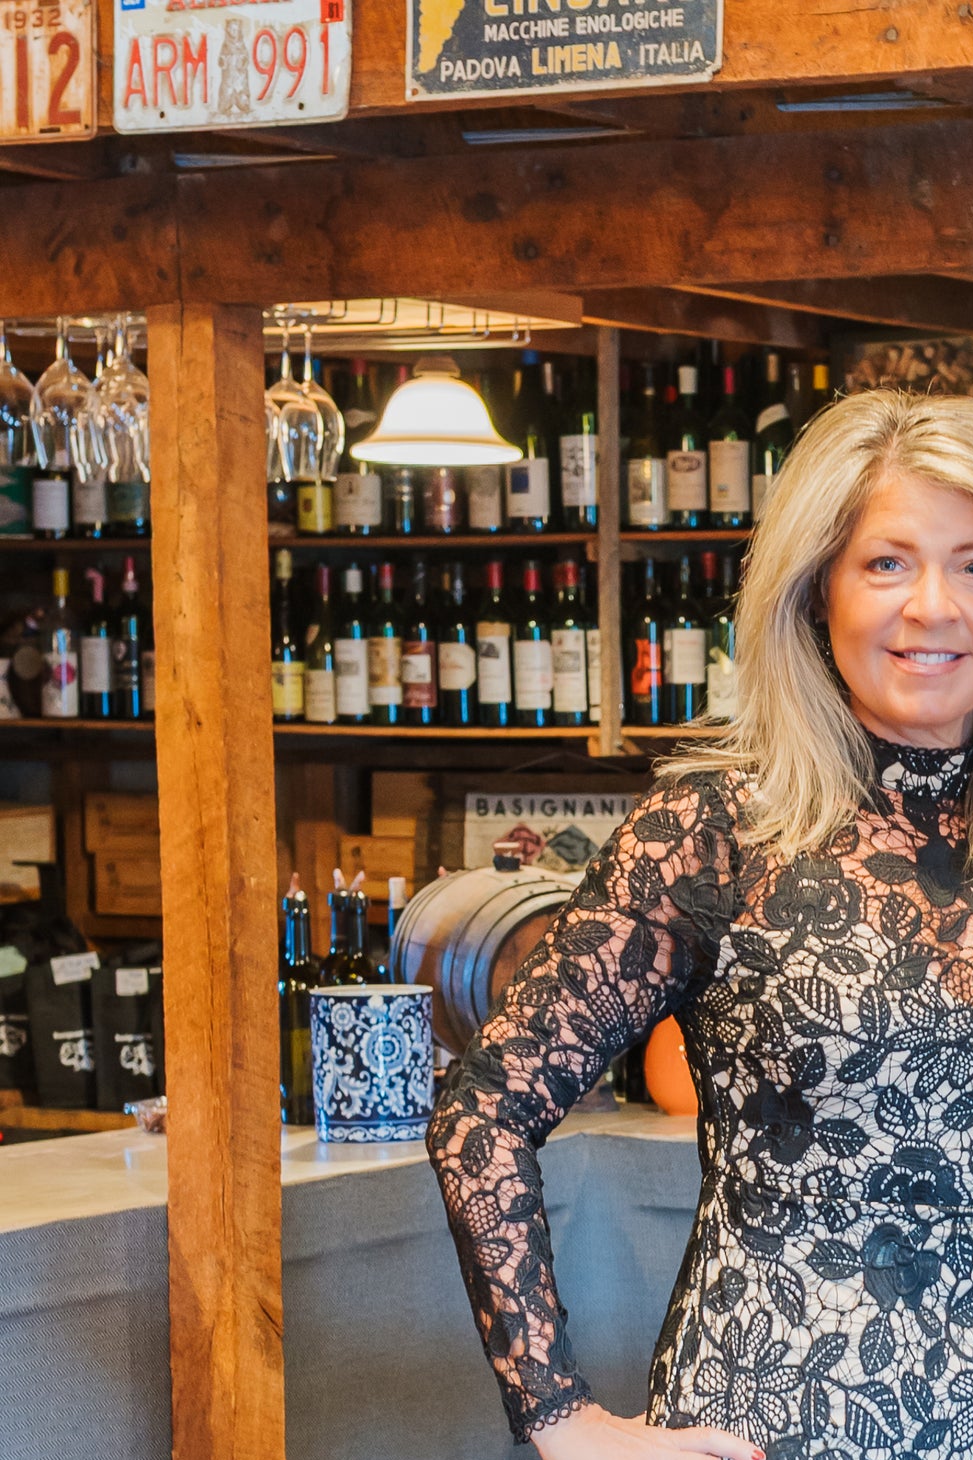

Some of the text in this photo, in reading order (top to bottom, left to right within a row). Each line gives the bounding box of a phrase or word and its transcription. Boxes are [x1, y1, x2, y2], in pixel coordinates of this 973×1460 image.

[5, 8, 62, 30] 1932
[484, 17, 570, 43] MACCHINE
[575, 8, 685, 36] ENOLOGICHE
[15, 31, 82, 129] 12
[123, 22, 330, 109] ARM 991
[440, 40, 706, 82] PADOVA LIMENA ITALIA
[475, 797, 628, 818] BASIGNANI
